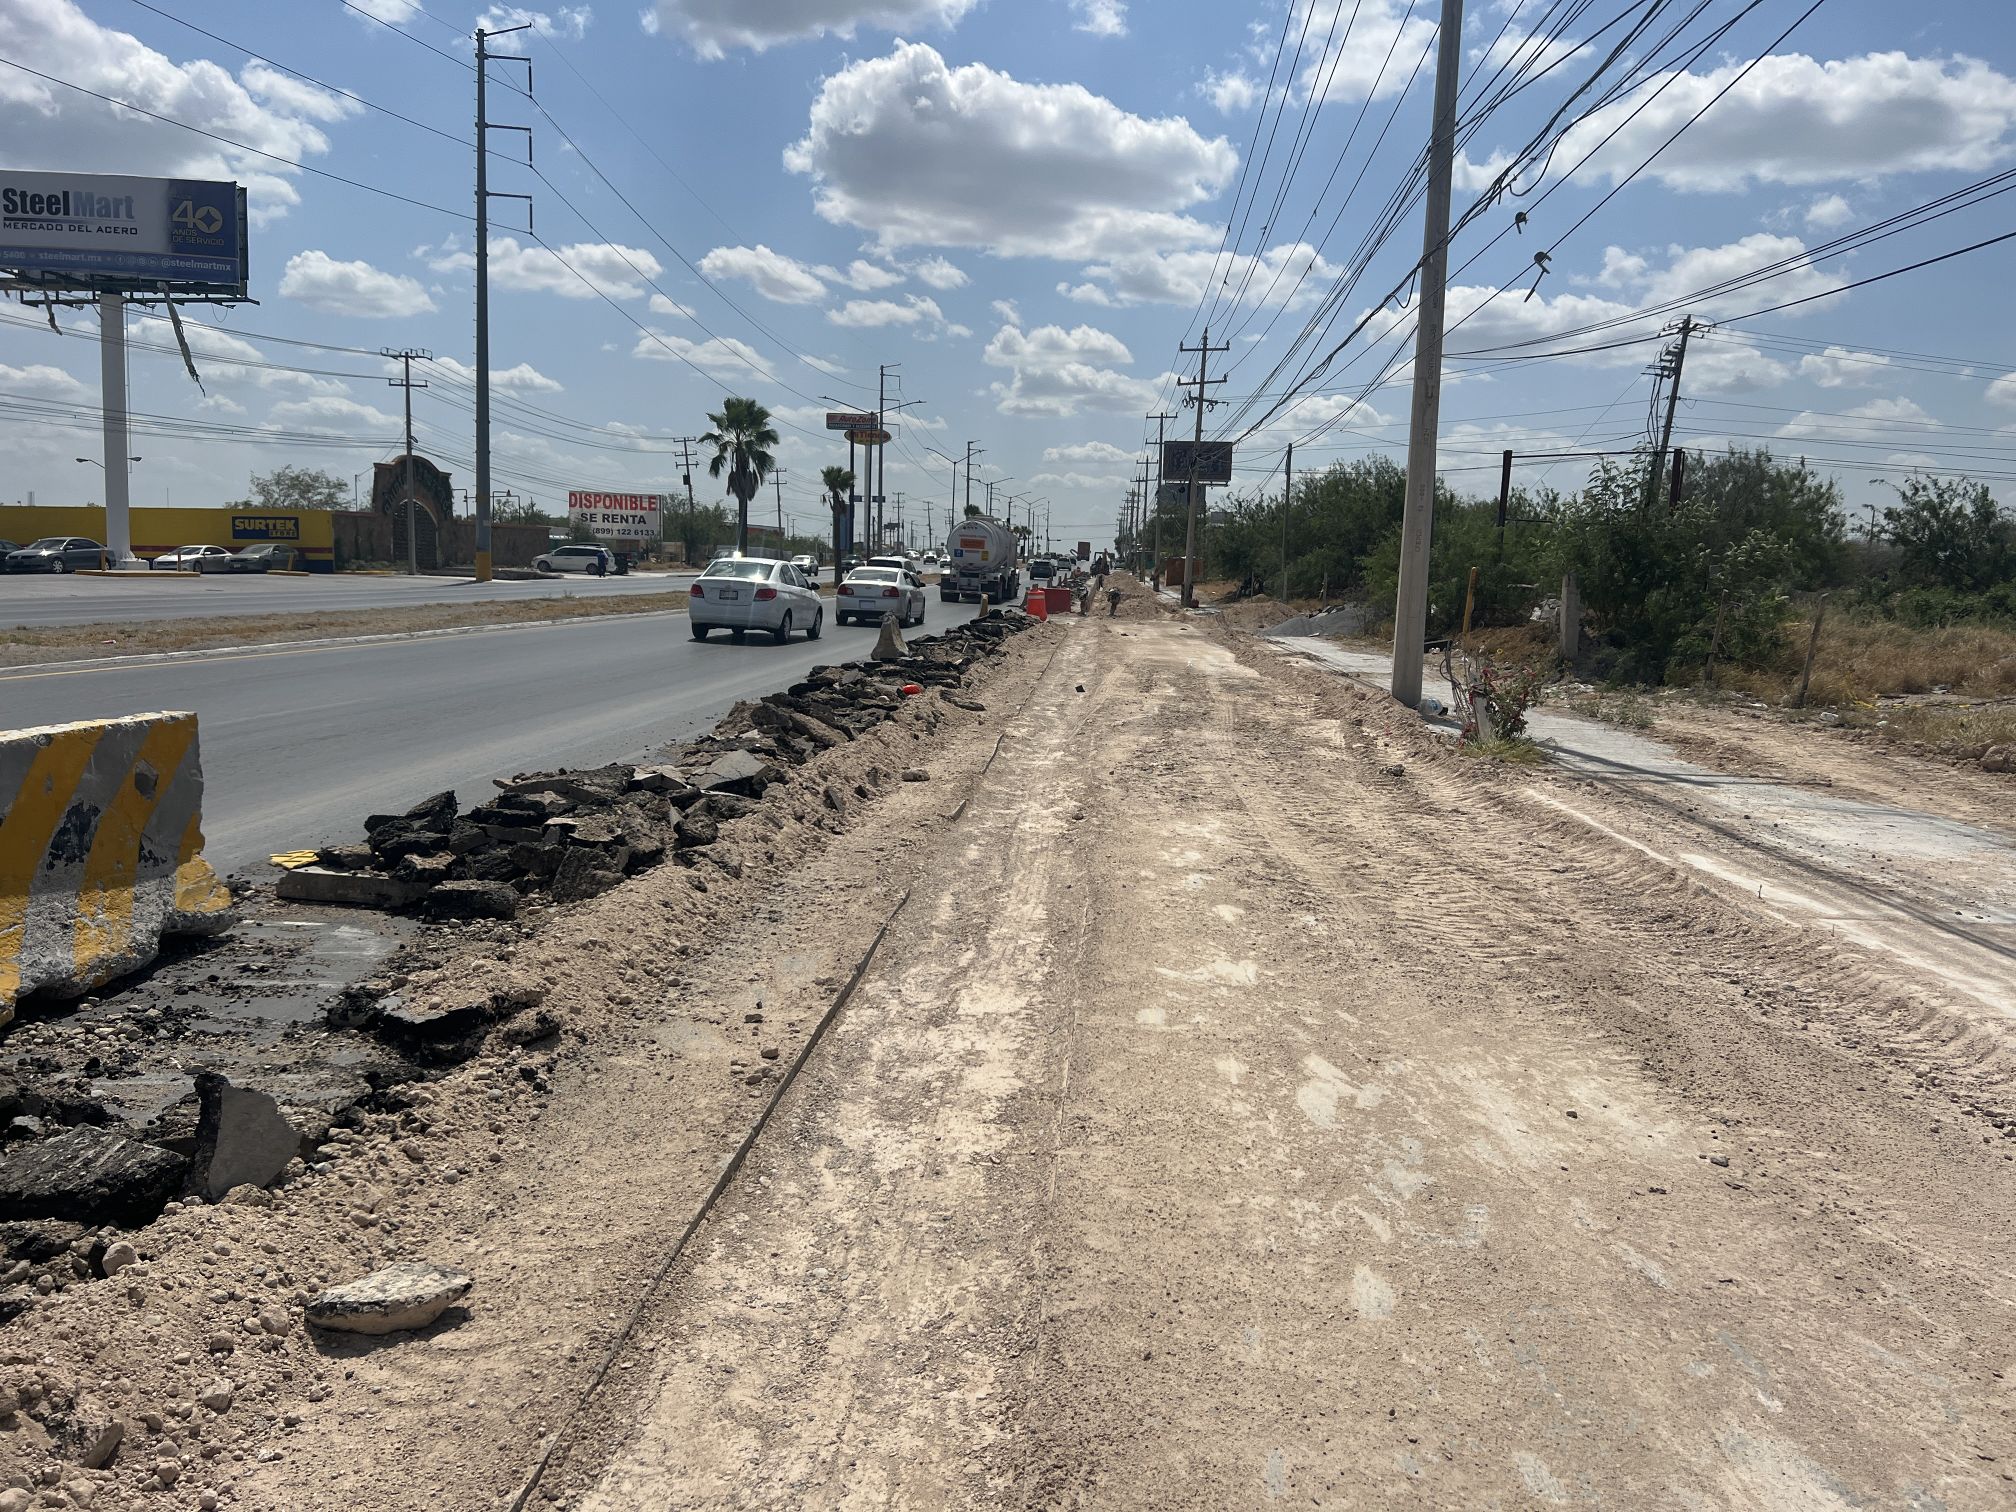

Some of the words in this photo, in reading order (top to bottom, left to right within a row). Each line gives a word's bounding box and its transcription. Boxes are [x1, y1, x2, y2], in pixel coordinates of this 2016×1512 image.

[2, 188, 135, 219] SteelMart
[172, 200, 223, 234] 40
[3, 221, 63, 231] MERCADO
[68, 224, 92, 233] DEL
[96, 225, 138, 235] ACERO
[185, 236, 225, 246] SERVICIO
[39, 251, 101, 262] steelmart.mx
[161, 257, 231, 271] @steelmartmx
[569, 493, 656, 511] DISPONIBLE
[235, 519, 296, 530] SURTEK
[580, 512, 598, 523] SE
[602, 513, 647, 525] RENTA
[592, 527, 614, 537] (899)
[616, 528, 632, 536] 122
